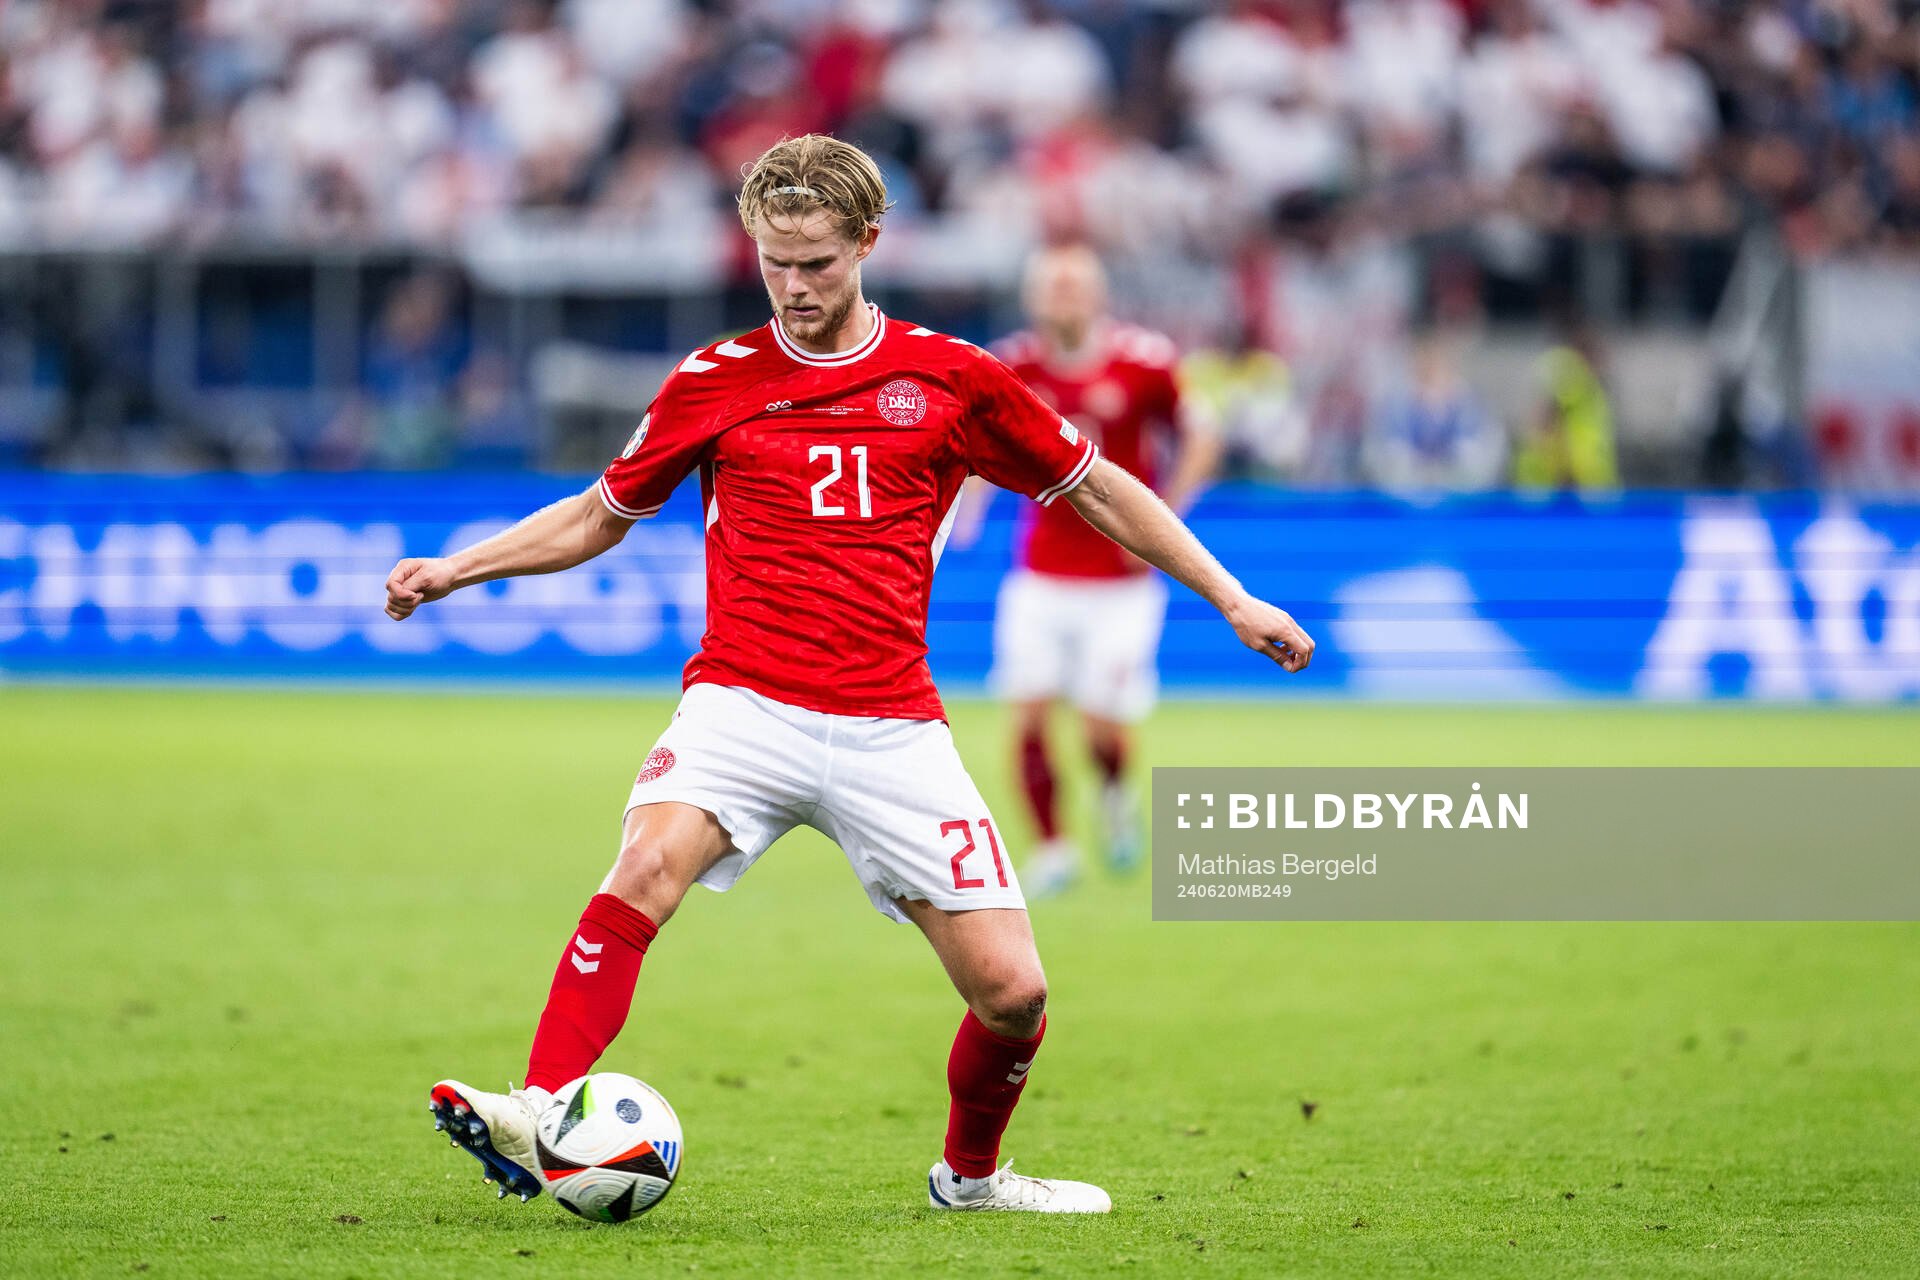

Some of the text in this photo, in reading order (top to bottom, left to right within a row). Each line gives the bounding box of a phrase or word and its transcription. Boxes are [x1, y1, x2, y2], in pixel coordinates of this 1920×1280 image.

[888, 395, 917, 409] DBU
[808, 445, 873, 518] 21
[940, 818, 1008, 890] 21
